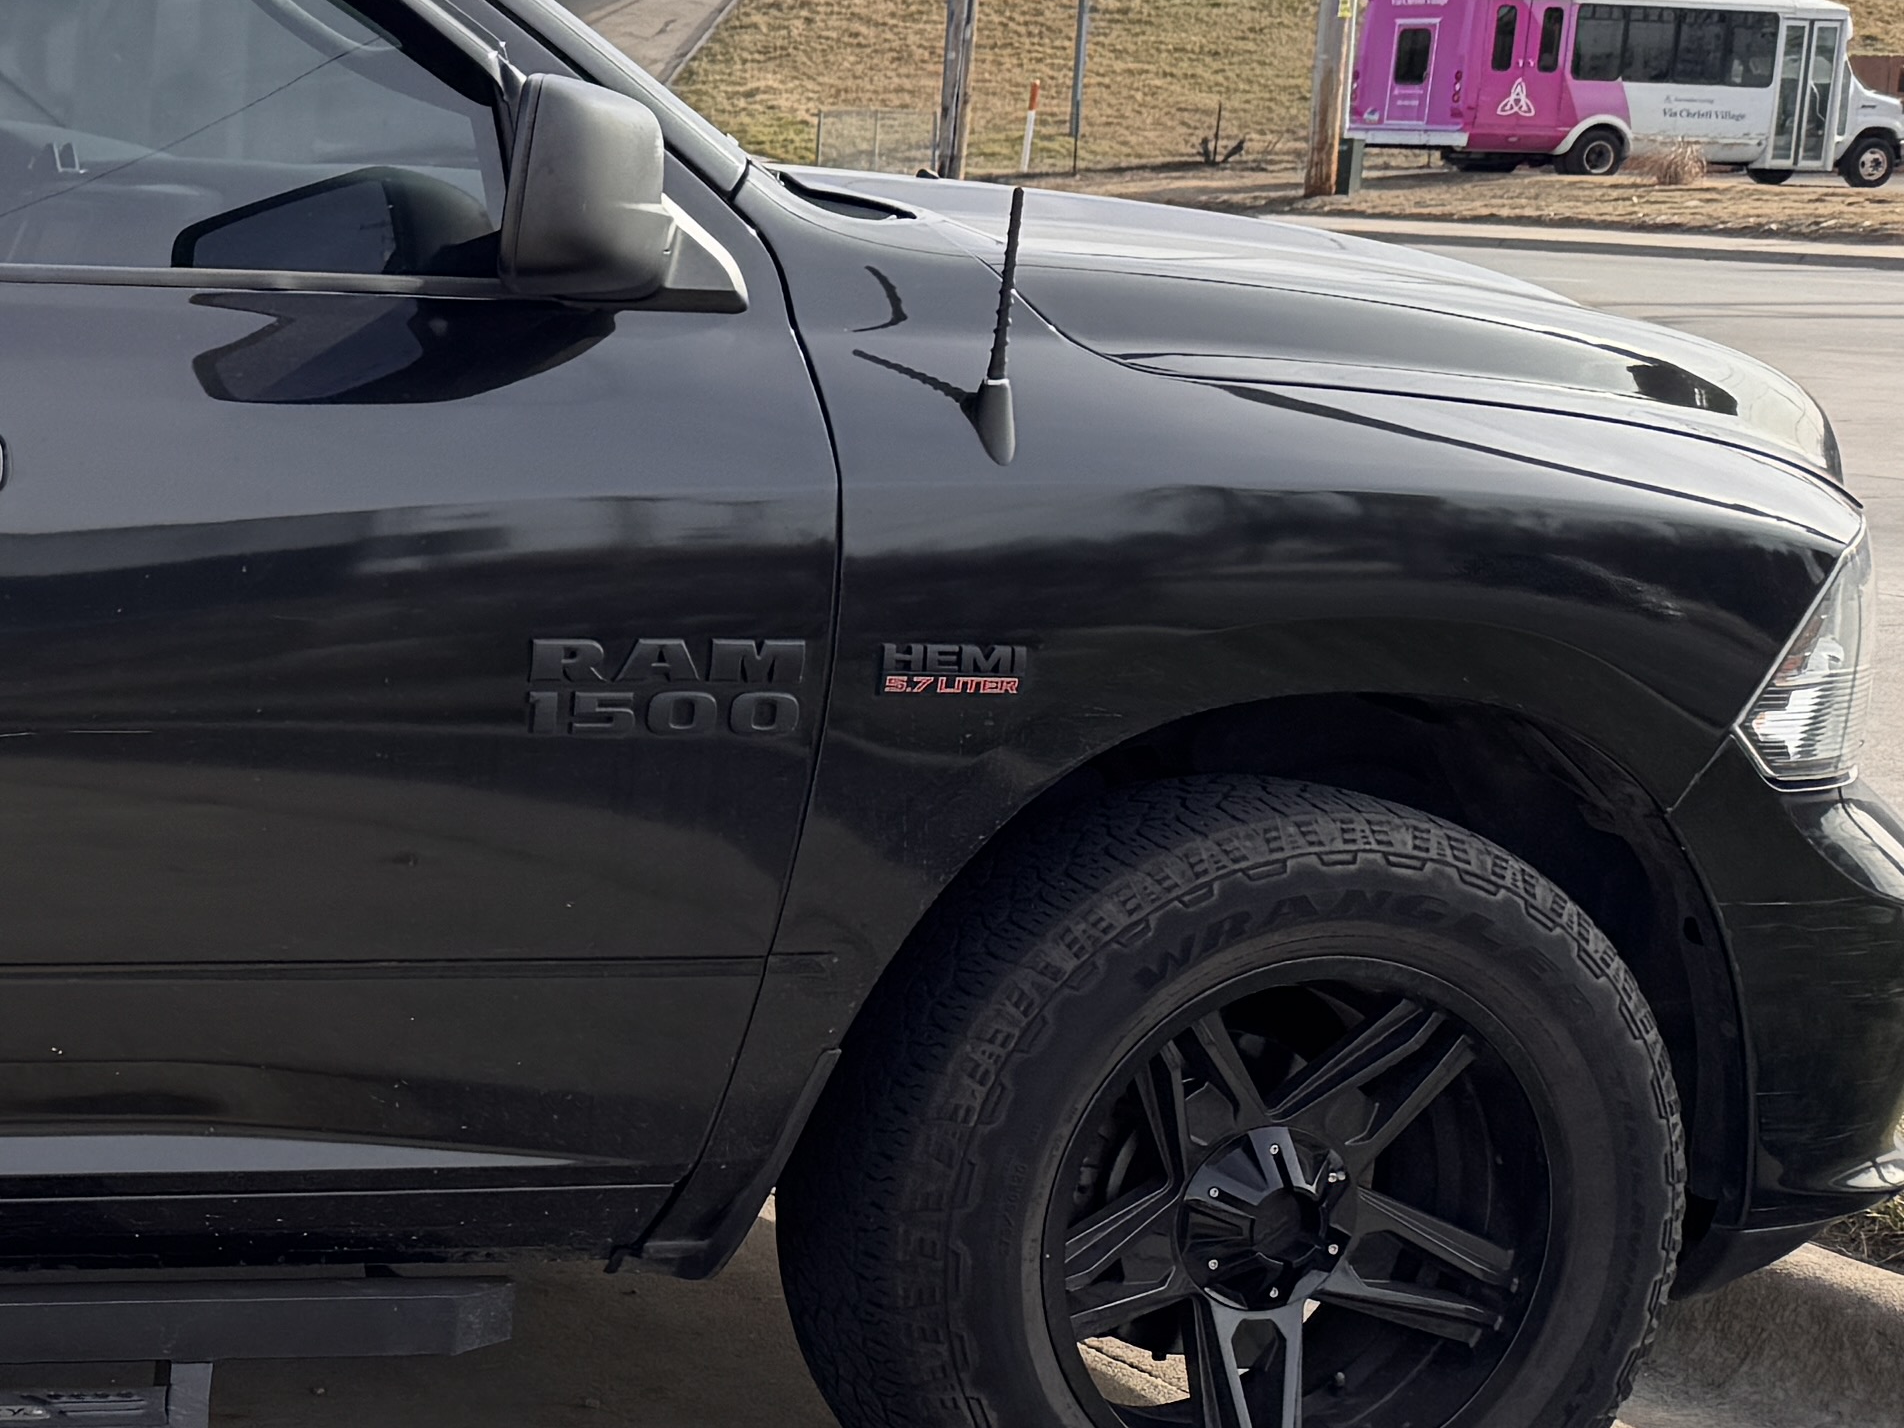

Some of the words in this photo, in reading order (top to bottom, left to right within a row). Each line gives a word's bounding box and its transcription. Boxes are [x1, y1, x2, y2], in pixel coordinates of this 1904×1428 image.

[1679, 108, 1712, 120] Christi
[1714, 110, 1747, 122] Village
[527, 637, 807, 685] RAM
[881, 643, 1028, 676] HEMI
[884, 676, 935, 693] 5.7
[937, 677, 1020, 694] LITER
[527, 691, 801, 736] 1500
